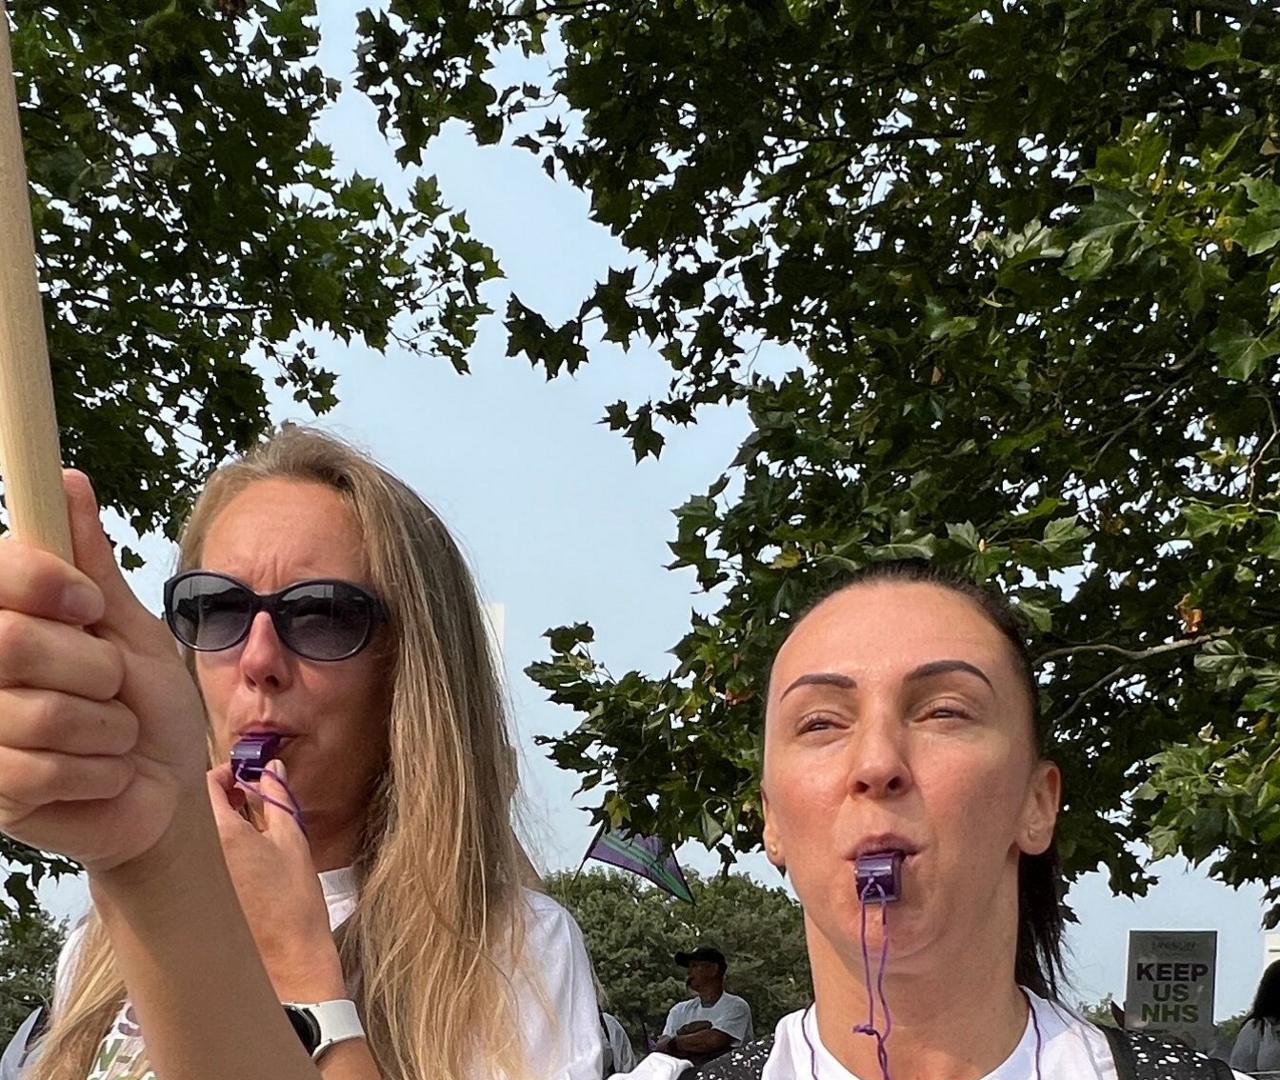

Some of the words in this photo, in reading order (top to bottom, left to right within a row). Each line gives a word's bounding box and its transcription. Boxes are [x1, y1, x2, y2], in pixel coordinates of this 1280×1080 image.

[1135, 962, 1209, 982] KEEP
[1152, 982, 1190, 1002] US
[1140, 1003, 1200, 1024] NHS
